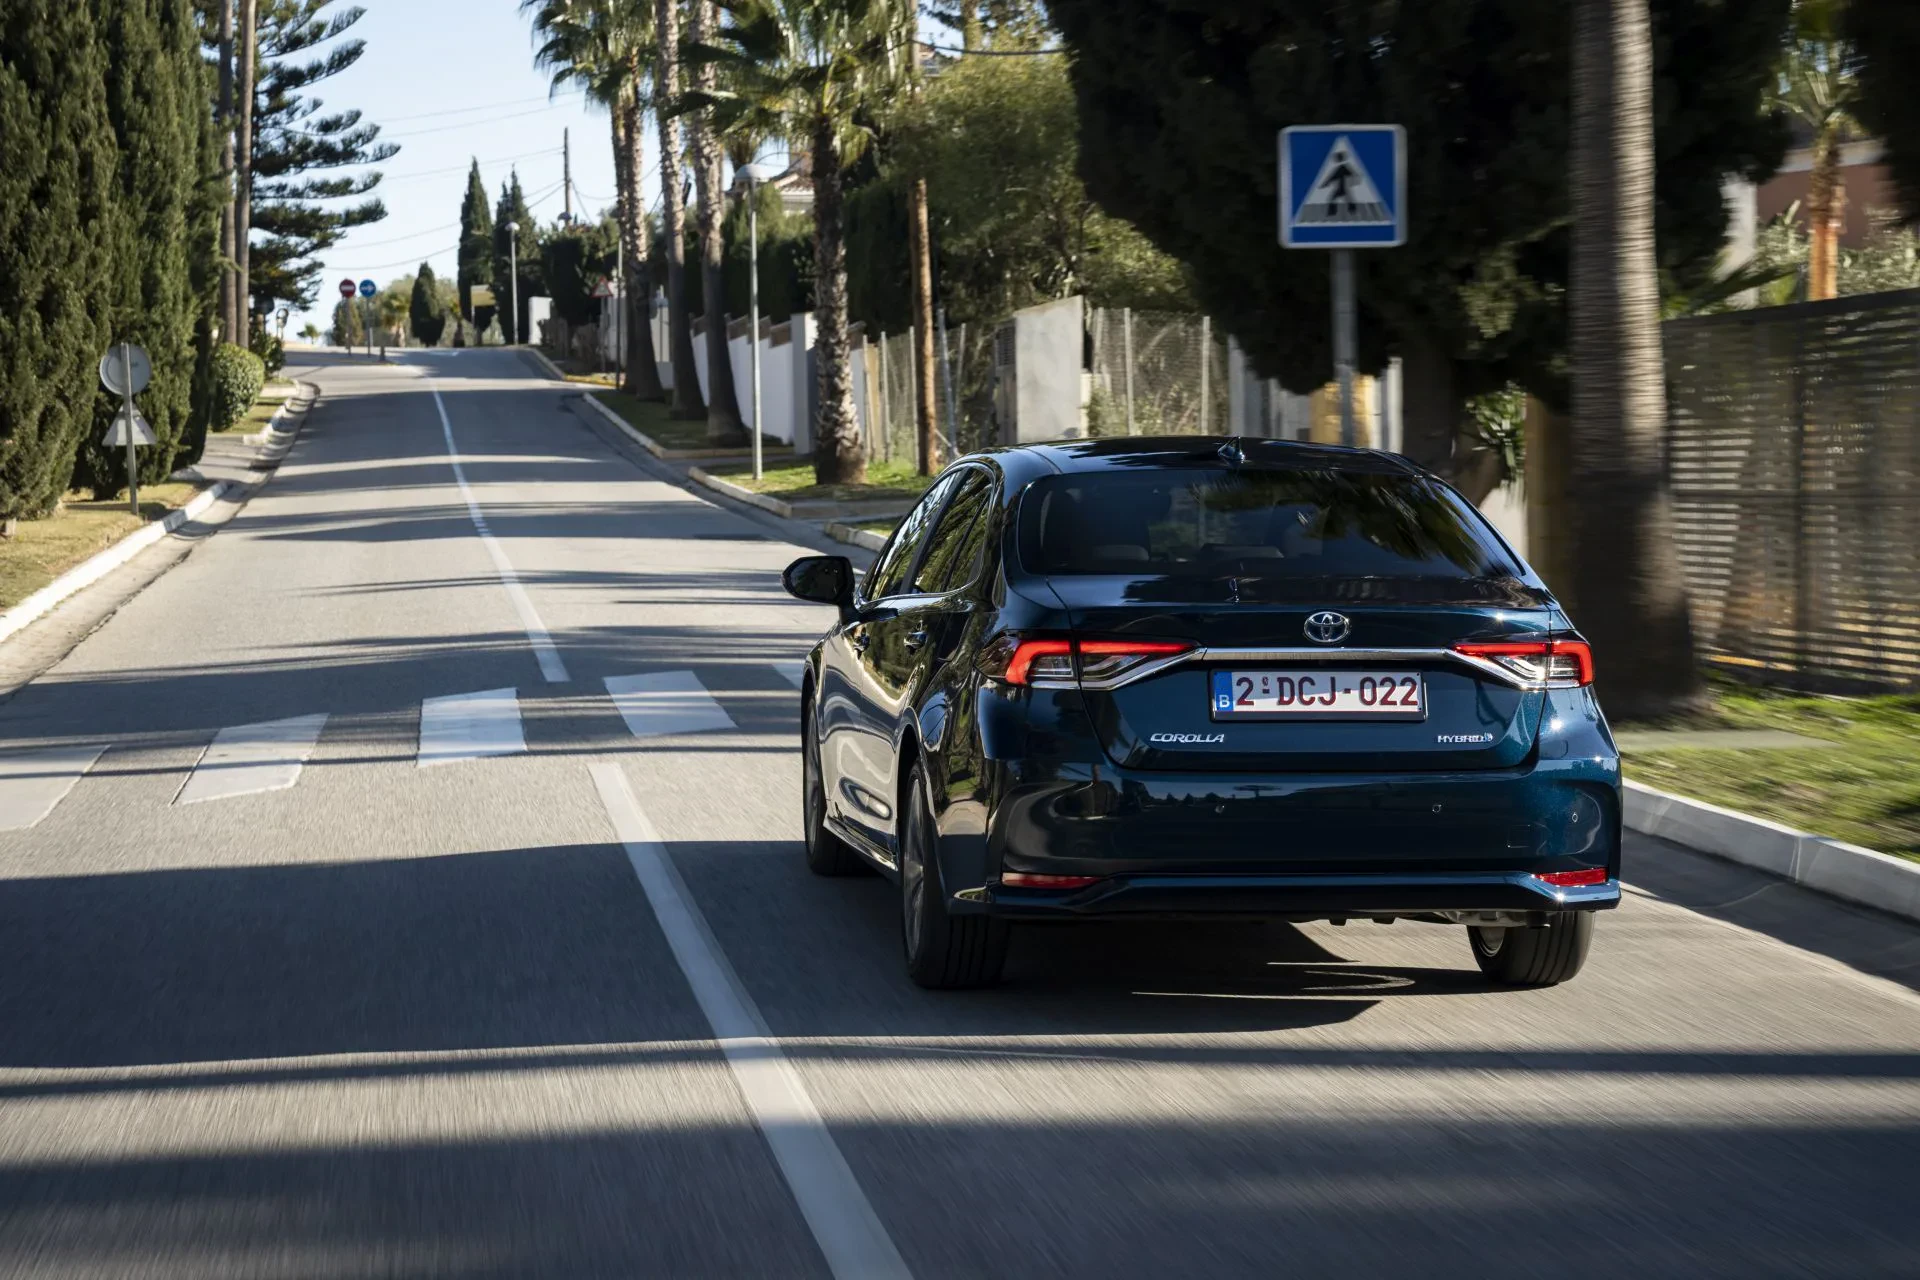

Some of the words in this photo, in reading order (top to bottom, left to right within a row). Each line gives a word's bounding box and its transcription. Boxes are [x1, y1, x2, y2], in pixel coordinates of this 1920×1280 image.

[1219, 694, 1230, 708] B
[1150, 733, 1225, 743] COROLLA
[1437, 734, 1484, 743] HYBRID
